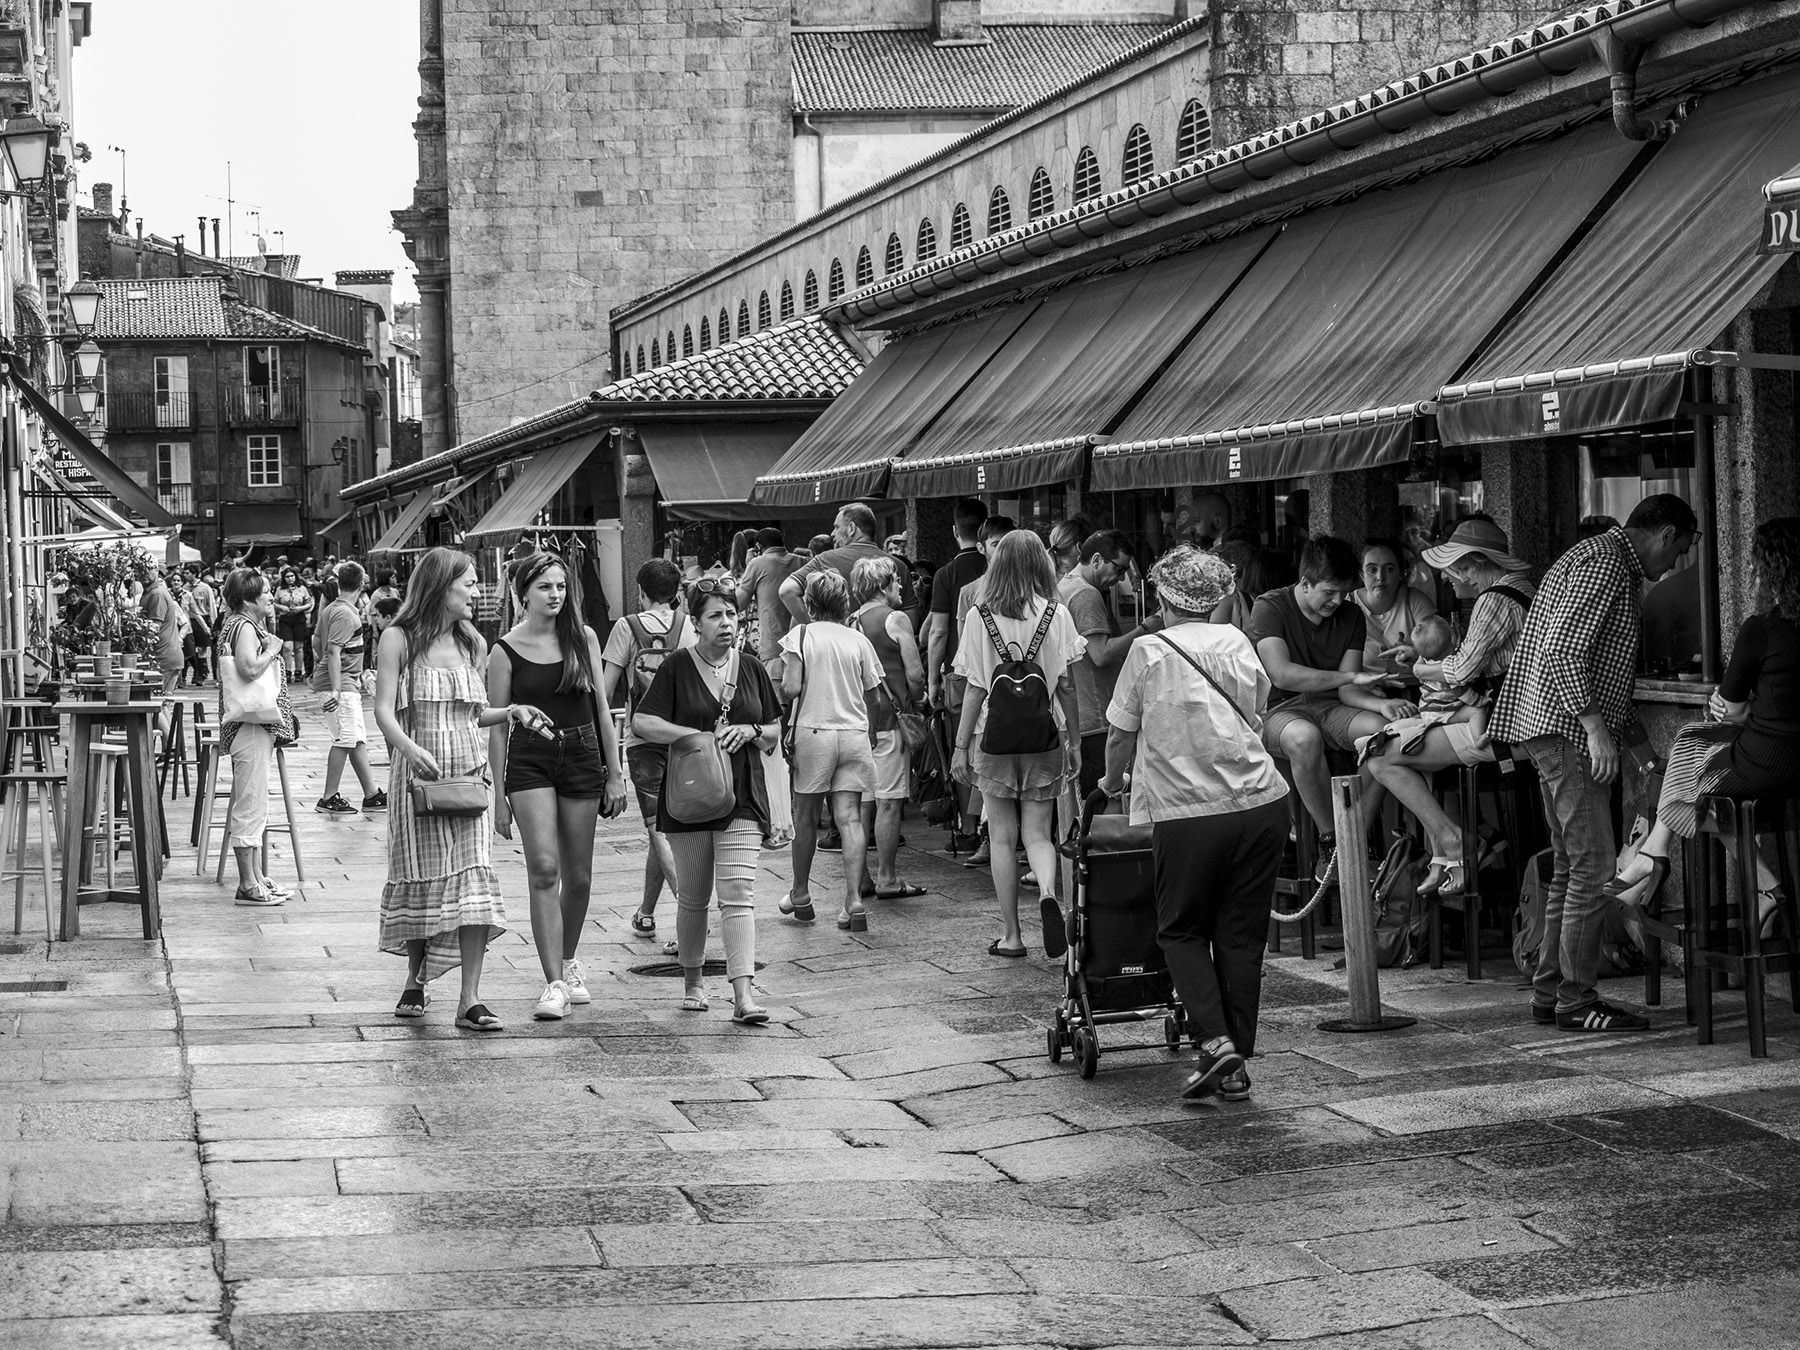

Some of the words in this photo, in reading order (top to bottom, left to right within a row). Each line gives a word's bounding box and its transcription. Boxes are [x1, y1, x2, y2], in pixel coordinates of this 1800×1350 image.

[984, 615, 998, 635] SMITH
[1029, 633, 1044, 654] JACKIE
[1037, 614, 1052, 634] SMITH
[992, 634, 1007, 655] JACKIE
